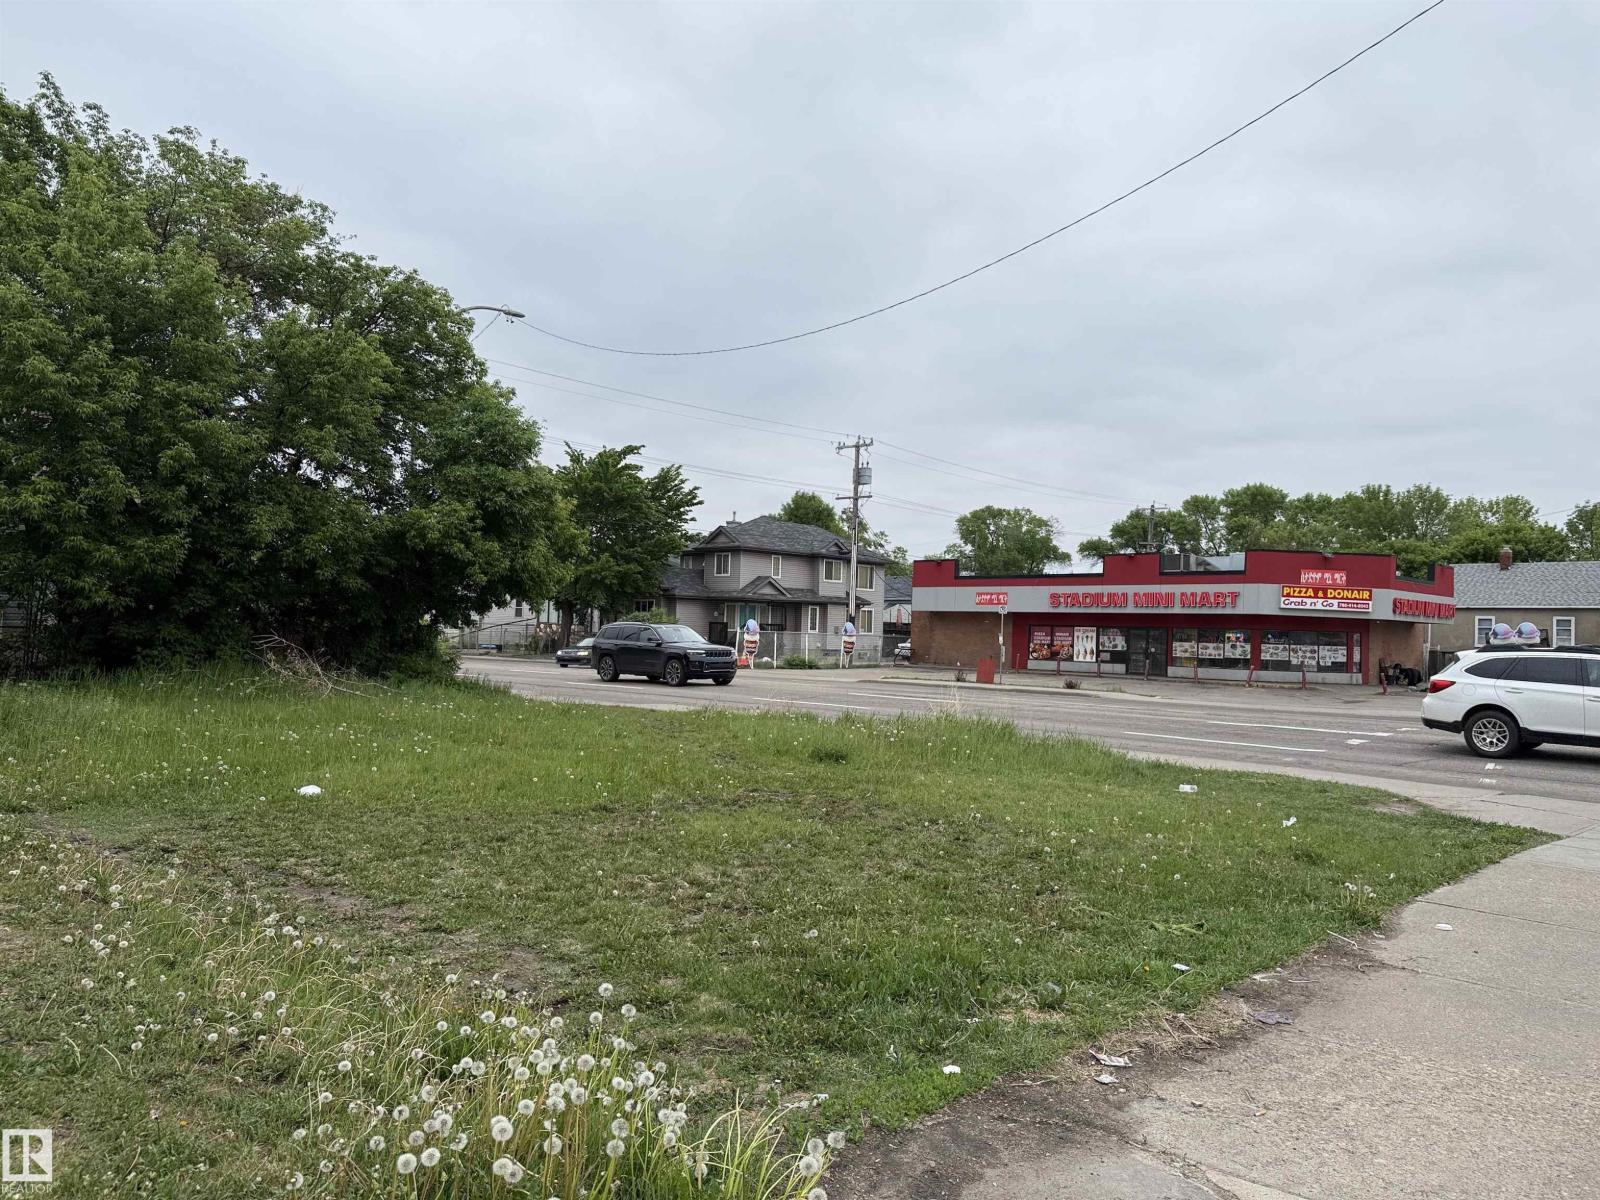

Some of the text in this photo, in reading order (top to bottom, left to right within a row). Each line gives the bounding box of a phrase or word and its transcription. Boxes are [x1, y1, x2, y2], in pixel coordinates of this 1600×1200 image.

[1048, 592, 1240, 607] STADIUM MINI MART
[1283, 587, 1314, 597] PIZZA
[1327, 589, 1370, 599] DONAIR
[1283, 599, 1307, 607] Grab
[1321, 600, 1334, 608] Go
[1393, 598, 1456, 618] STADIUM MINI MART
